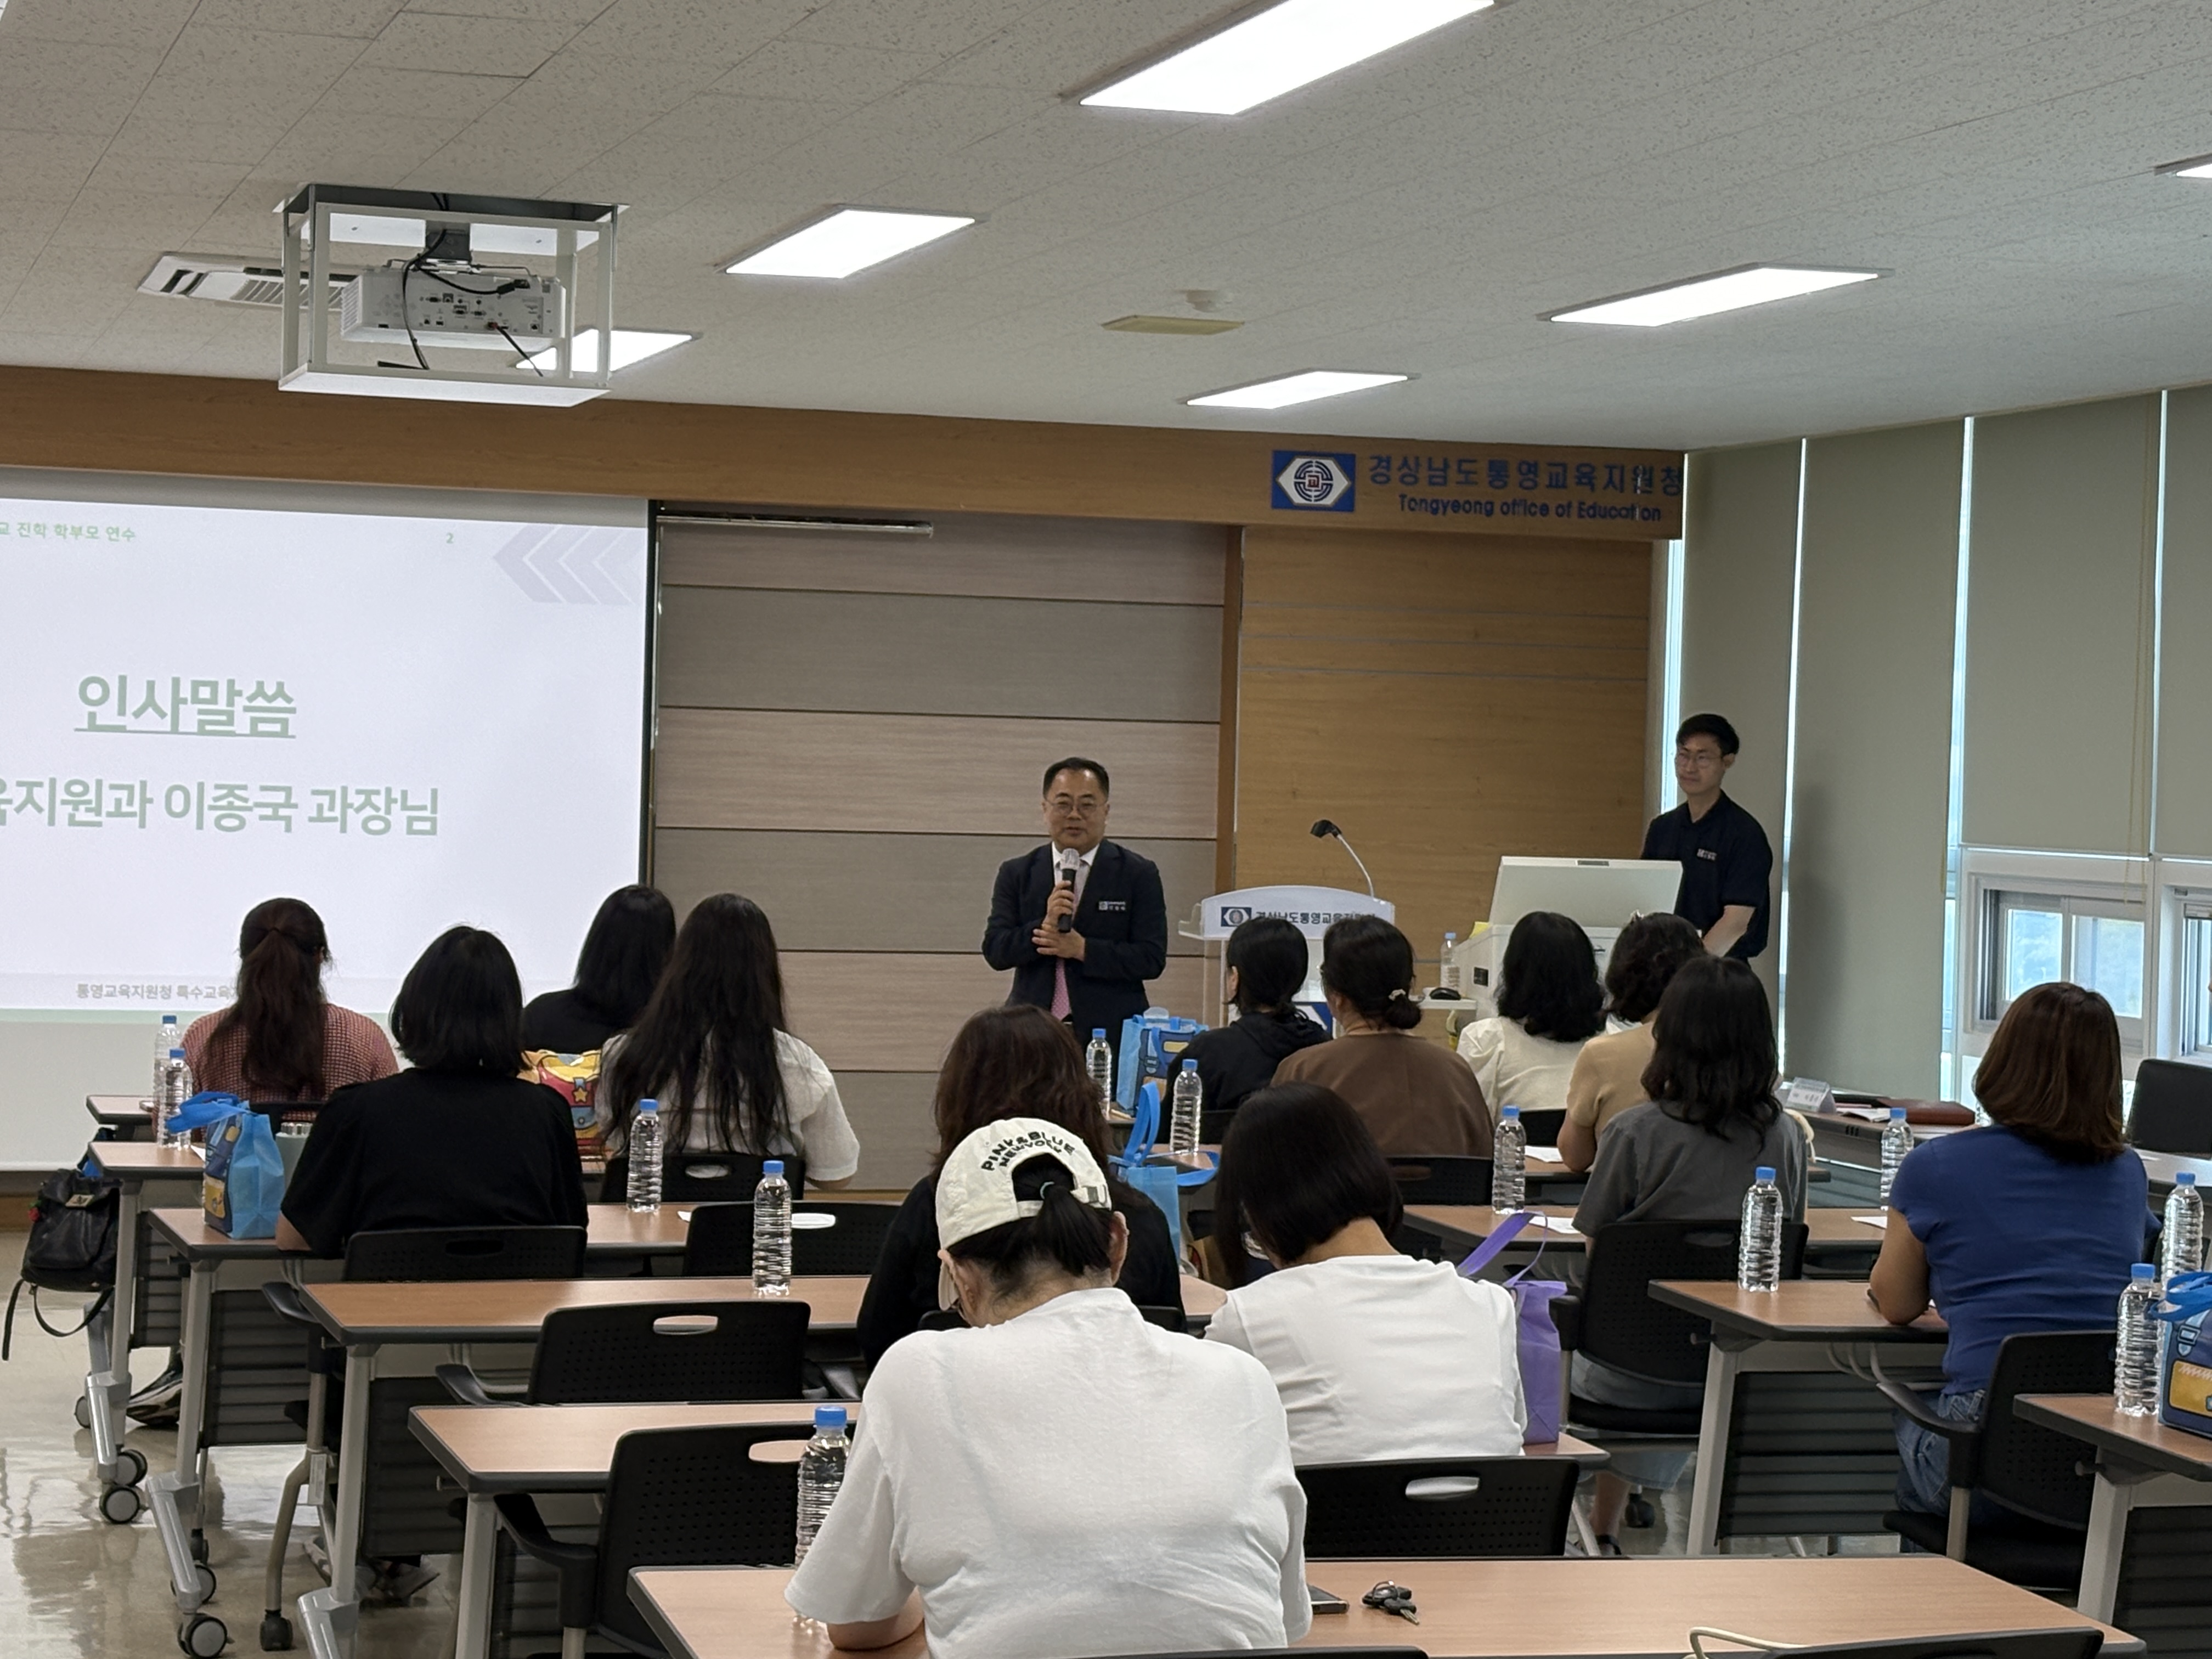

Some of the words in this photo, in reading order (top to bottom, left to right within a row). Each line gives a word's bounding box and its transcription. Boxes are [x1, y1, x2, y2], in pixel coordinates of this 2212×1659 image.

[1368, 454, 1682, 497] 경상남도통영교육지원청
[1399, 493, 1494, 517] Tongyeong
[1500, 498, 1549, 518] office
[1555, 500, 1572, 518] of
[1578, 501, 1661, 522] Education
[17, 522, 46, 538] 진학
[54, 523, 100, 540] 학부모
[106, 526, 136, 542] 연수
[445, 533, 454, 544] 2
[77, 674, 297, 736] 인사말씀
[164, 782, 298, 832] 이종국
[308, 786, 439, 836] 과장님
[77, 983, 172, 1000] 통영교육지원청
